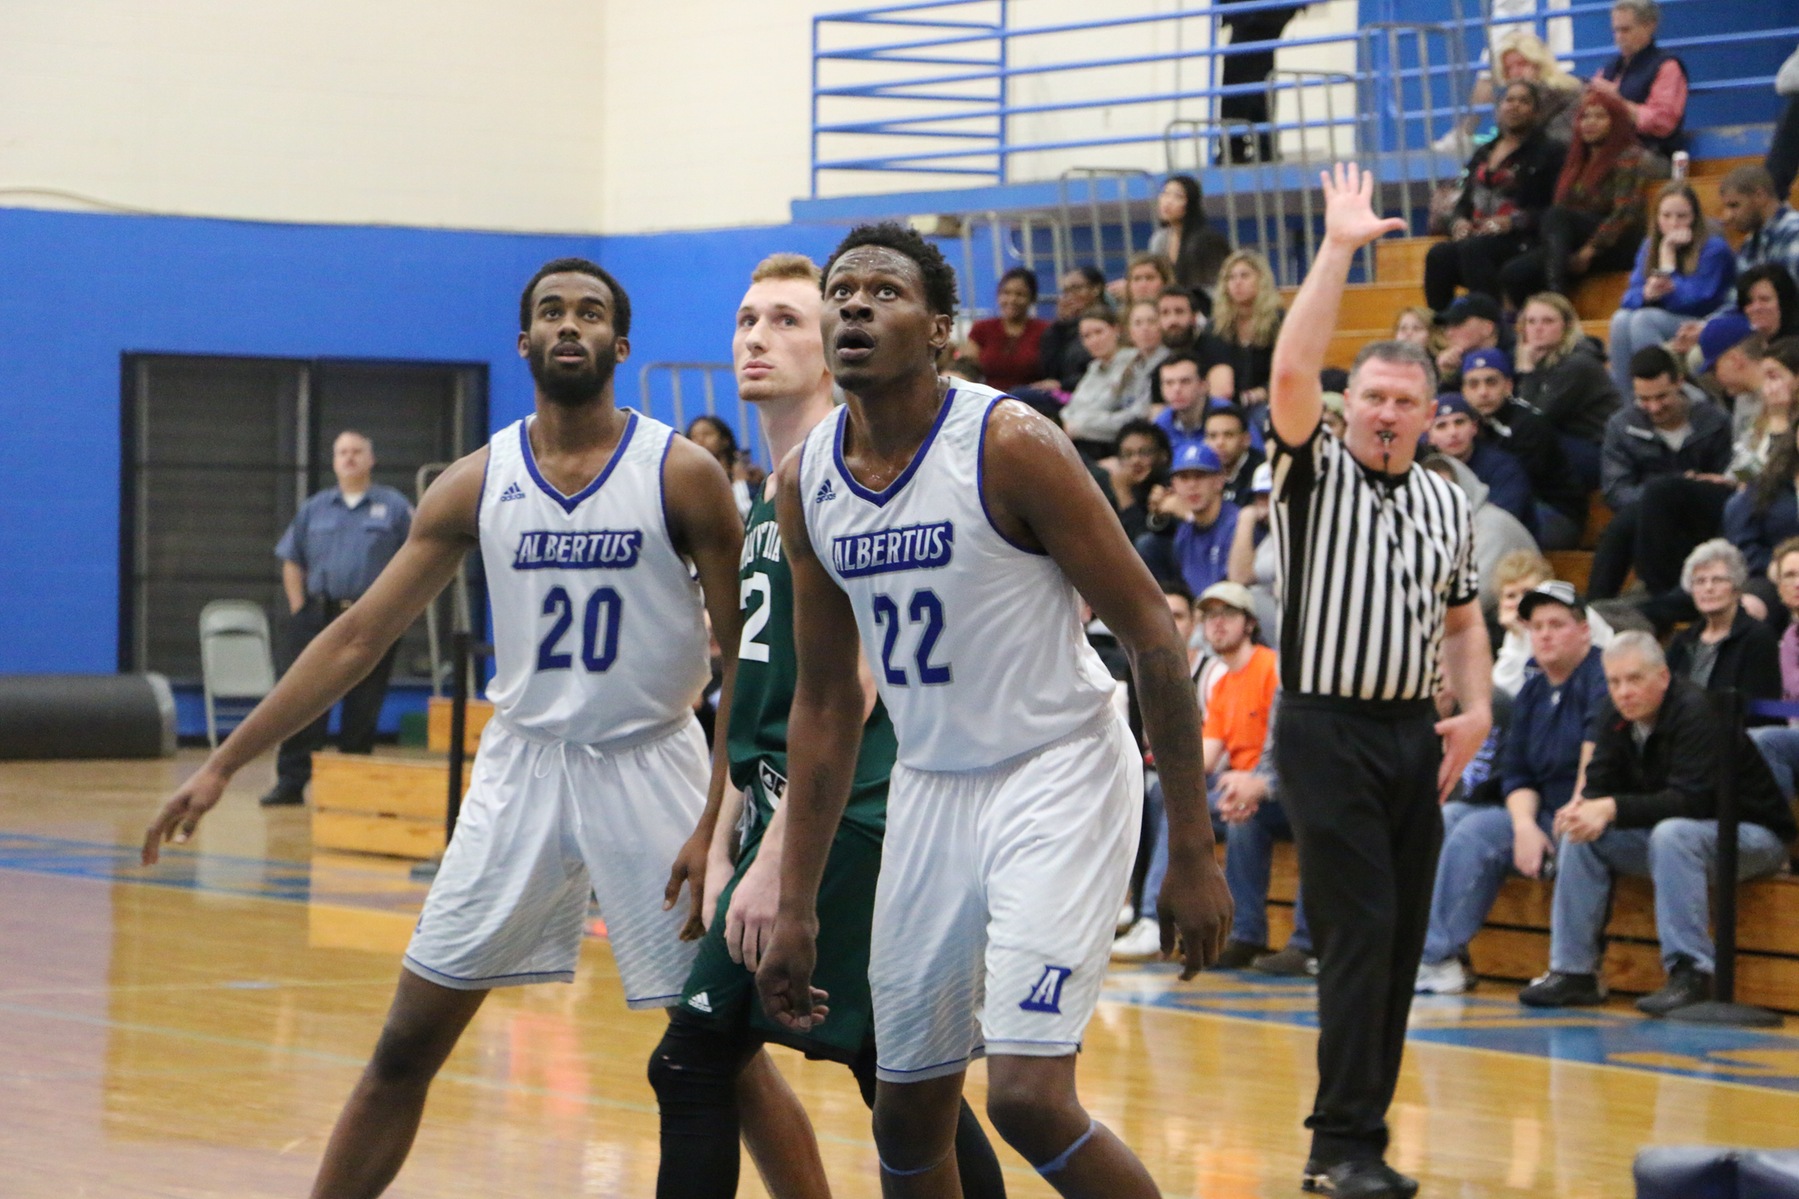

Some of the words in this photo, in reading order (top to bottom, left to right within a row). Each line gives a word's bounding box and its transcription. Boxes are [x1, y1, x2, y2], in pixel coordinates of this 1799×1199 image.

[517, 533, 636, 565] ALBERTUS
[834, 526, 947, 573] ALBERTUS
[537, 585, 623, 674] 20
[873, 588, 952, 687] 22
[1026, 966, 1065, 1009] A
